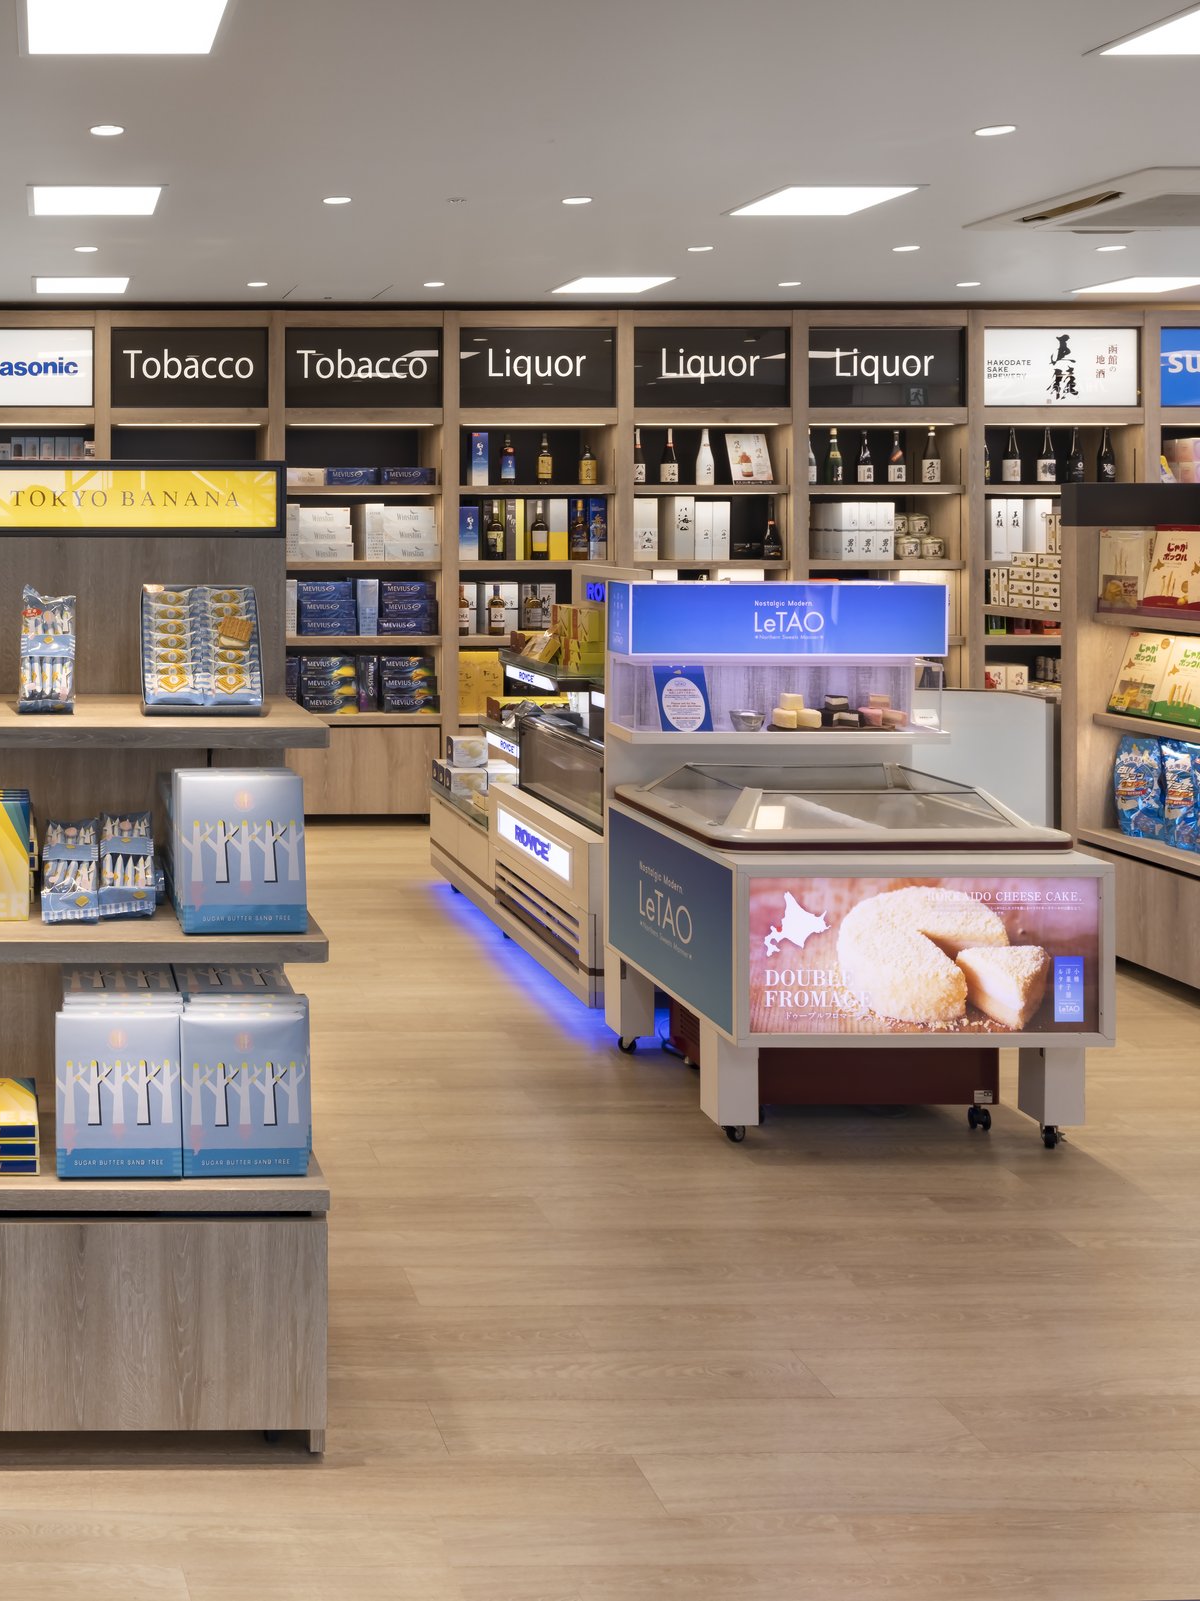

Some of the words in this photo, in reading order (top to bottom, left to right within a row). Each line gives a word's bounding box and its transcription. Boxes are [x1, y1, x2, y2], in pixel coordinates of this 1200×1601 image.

[122, 349, 254, 379] Tobacco
[296, 349, 428, 379] Tobacco
[488, 348, 586, 384] Liquor
[661, 348, 760, 384] Liquor
[835, 348, 934, 384] Liquor
[1096, 355, 1106, 378] 地酒
[10, 490, 108, 508] TOKYO
[120, 490, 240, 508] BANANA
[312, 514, 334, 522] Winston
[396, 512, 419, 520] Winston
[314, 532, 336, 540] Winston
[399, 531, 422, 539] Winston
[402, 549, 424, 557] Winston
[1166, 542, 1188, 552] じゃが
[754, 612, 824, 632] LeTAO
[1139, 644, 1158, 654] じゃが
[640, 860, 662, 882] Nostalgic
[996, 892, 1042, 901] CHEESE
[1046, 892, 1082, 901] CAKE.
[640, 880, 692, 944] LeTAO
[764, 969, 855, 986] DOUBLE
[764, 990, 872, 1008] FROMAGE
[786, 1011, 862, 1020] ドゥーブルフロマー
